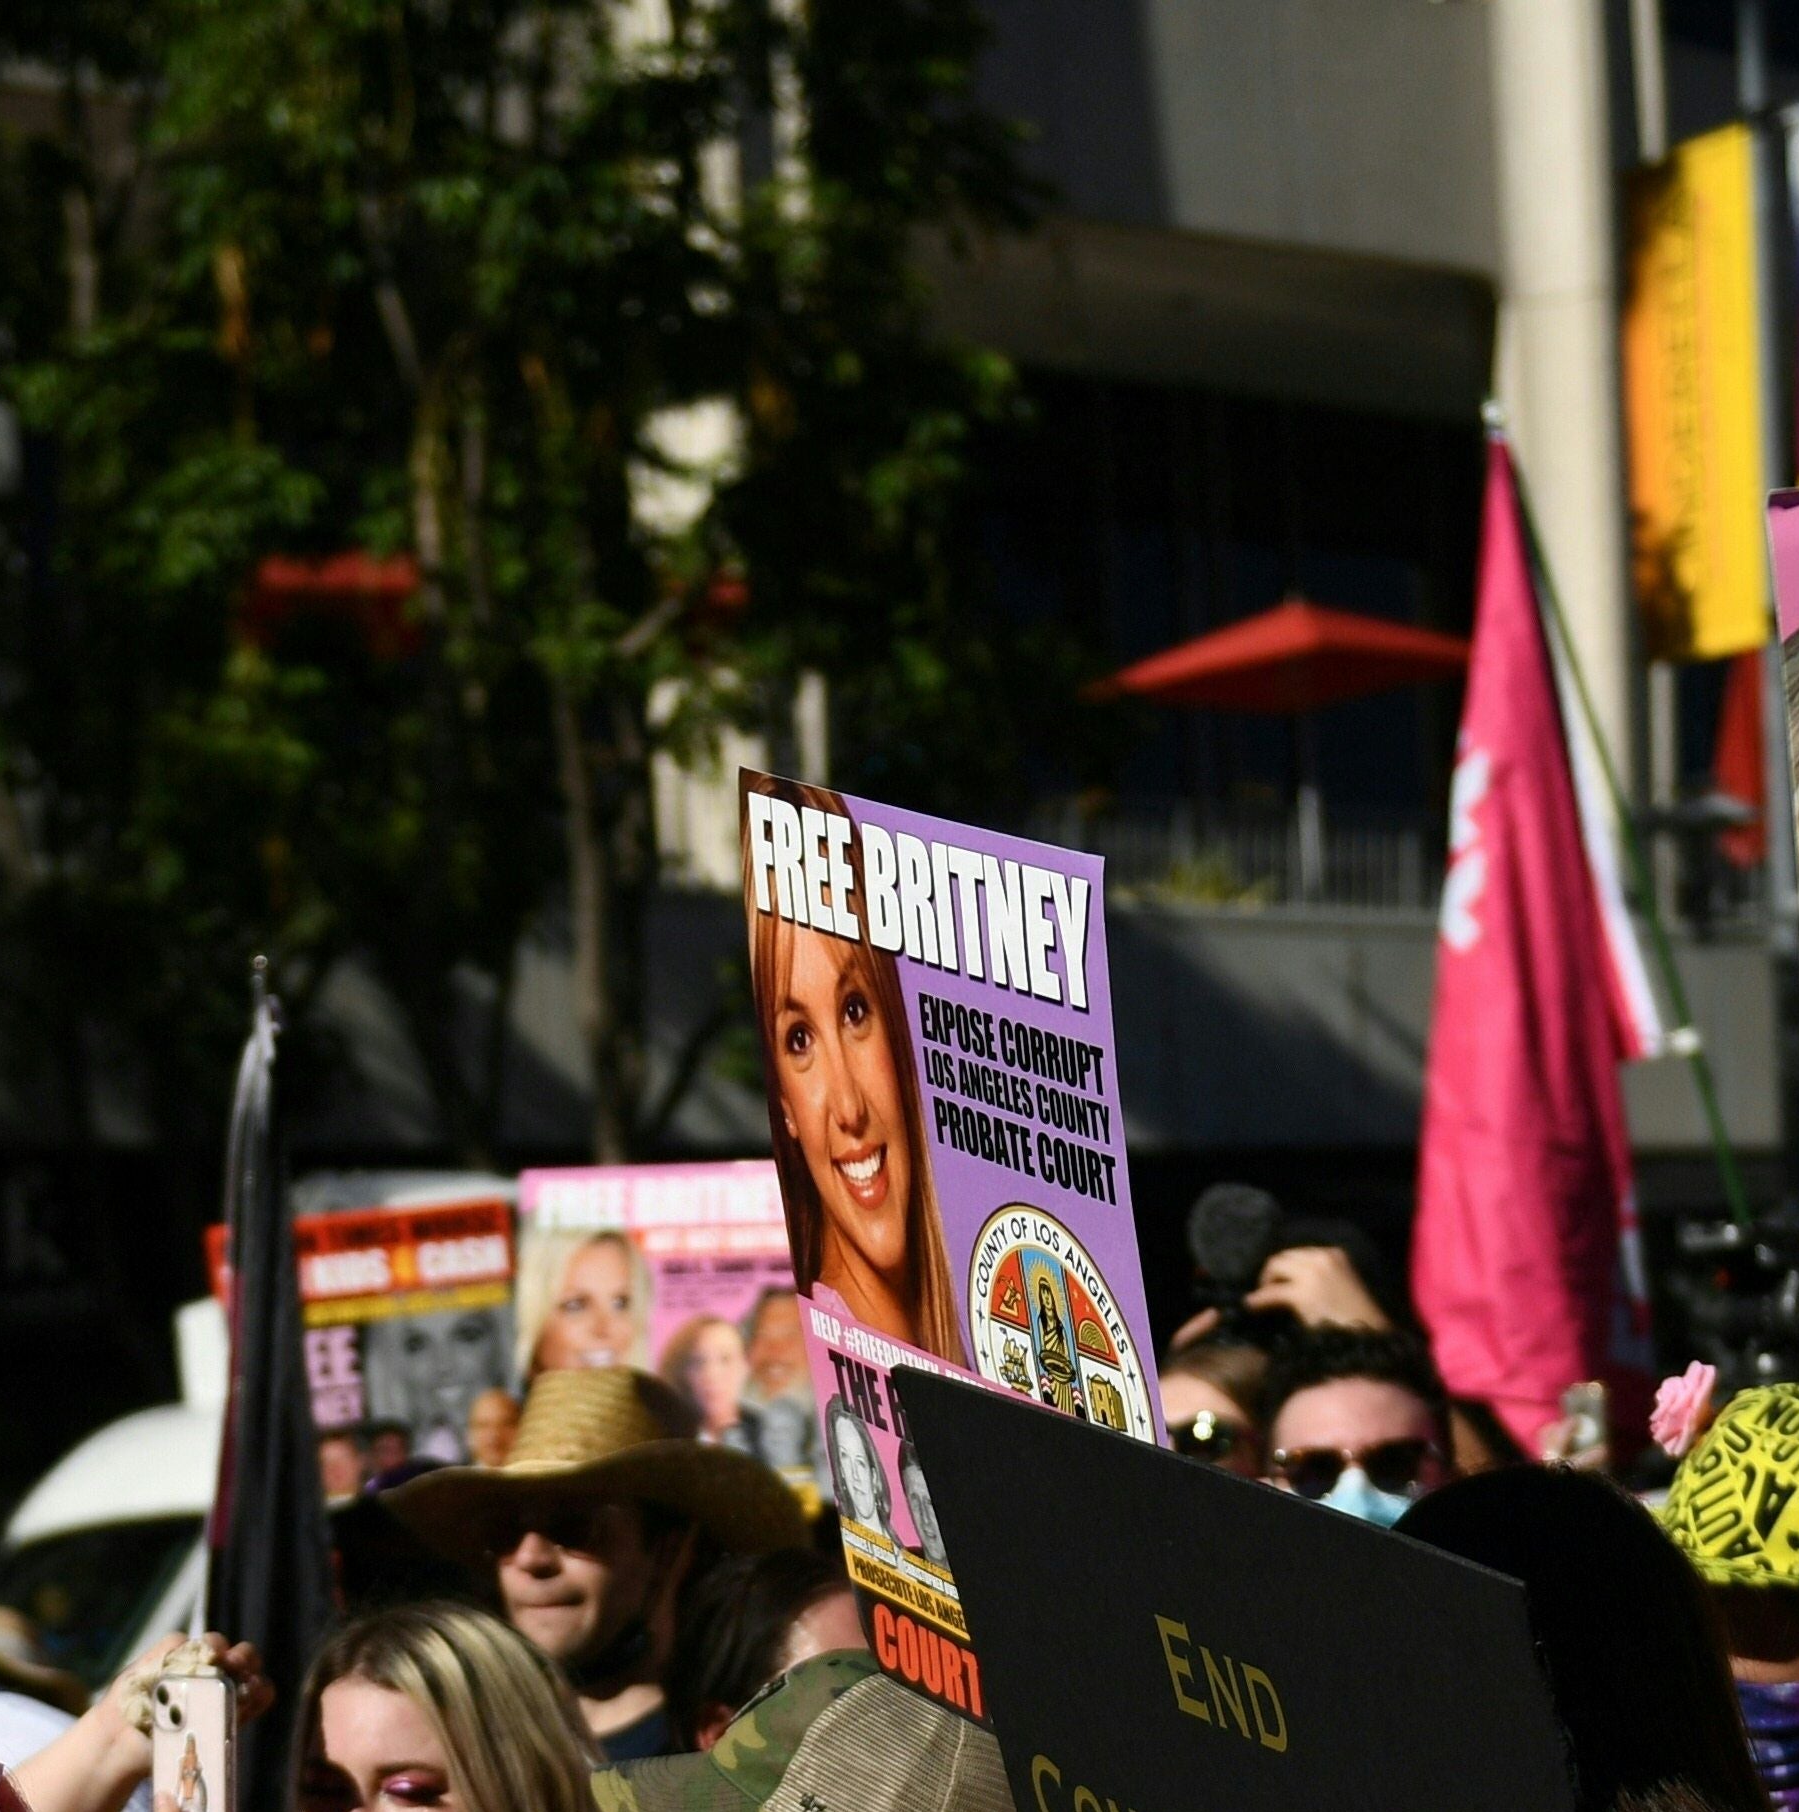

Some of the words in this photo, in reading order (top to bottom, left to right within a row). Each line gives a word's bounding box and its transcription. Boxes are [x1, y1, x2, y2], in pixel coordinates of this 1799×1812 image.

[748, 791, 860, 941] FREE
[860, 822, 1091, 1011] BRITNEY
[918, 992, 997, 1059] EXPOSE
[999, 1017, 1104, 1096] CORRUPT
[923, 1046, 956, 1093] LOS
[959, 1054, 1032, 1115] ANGELES
[1035, 1084, 1110, 1145] COUNTY
[932, 1096, 1036, 1177] PROBATE
[1037, 1132, 1116, 1206] COURT
[809, 1307, 841, 1346] HELP
[976, 1224, 1007, 1299] COUNTY
[1011, 1217, 1027, 1239] OF
[1033, 1218, 1061, 1252] LOS
[1064, 1246, 1129, 1355] ANGELES
[827, 1348, 890, 1432] THE
[853, 1554, 916, 1604] PROSECUTE
[913, 1586, 937, 1617] LOS
[1154, 1613, 1288, 1753] END
